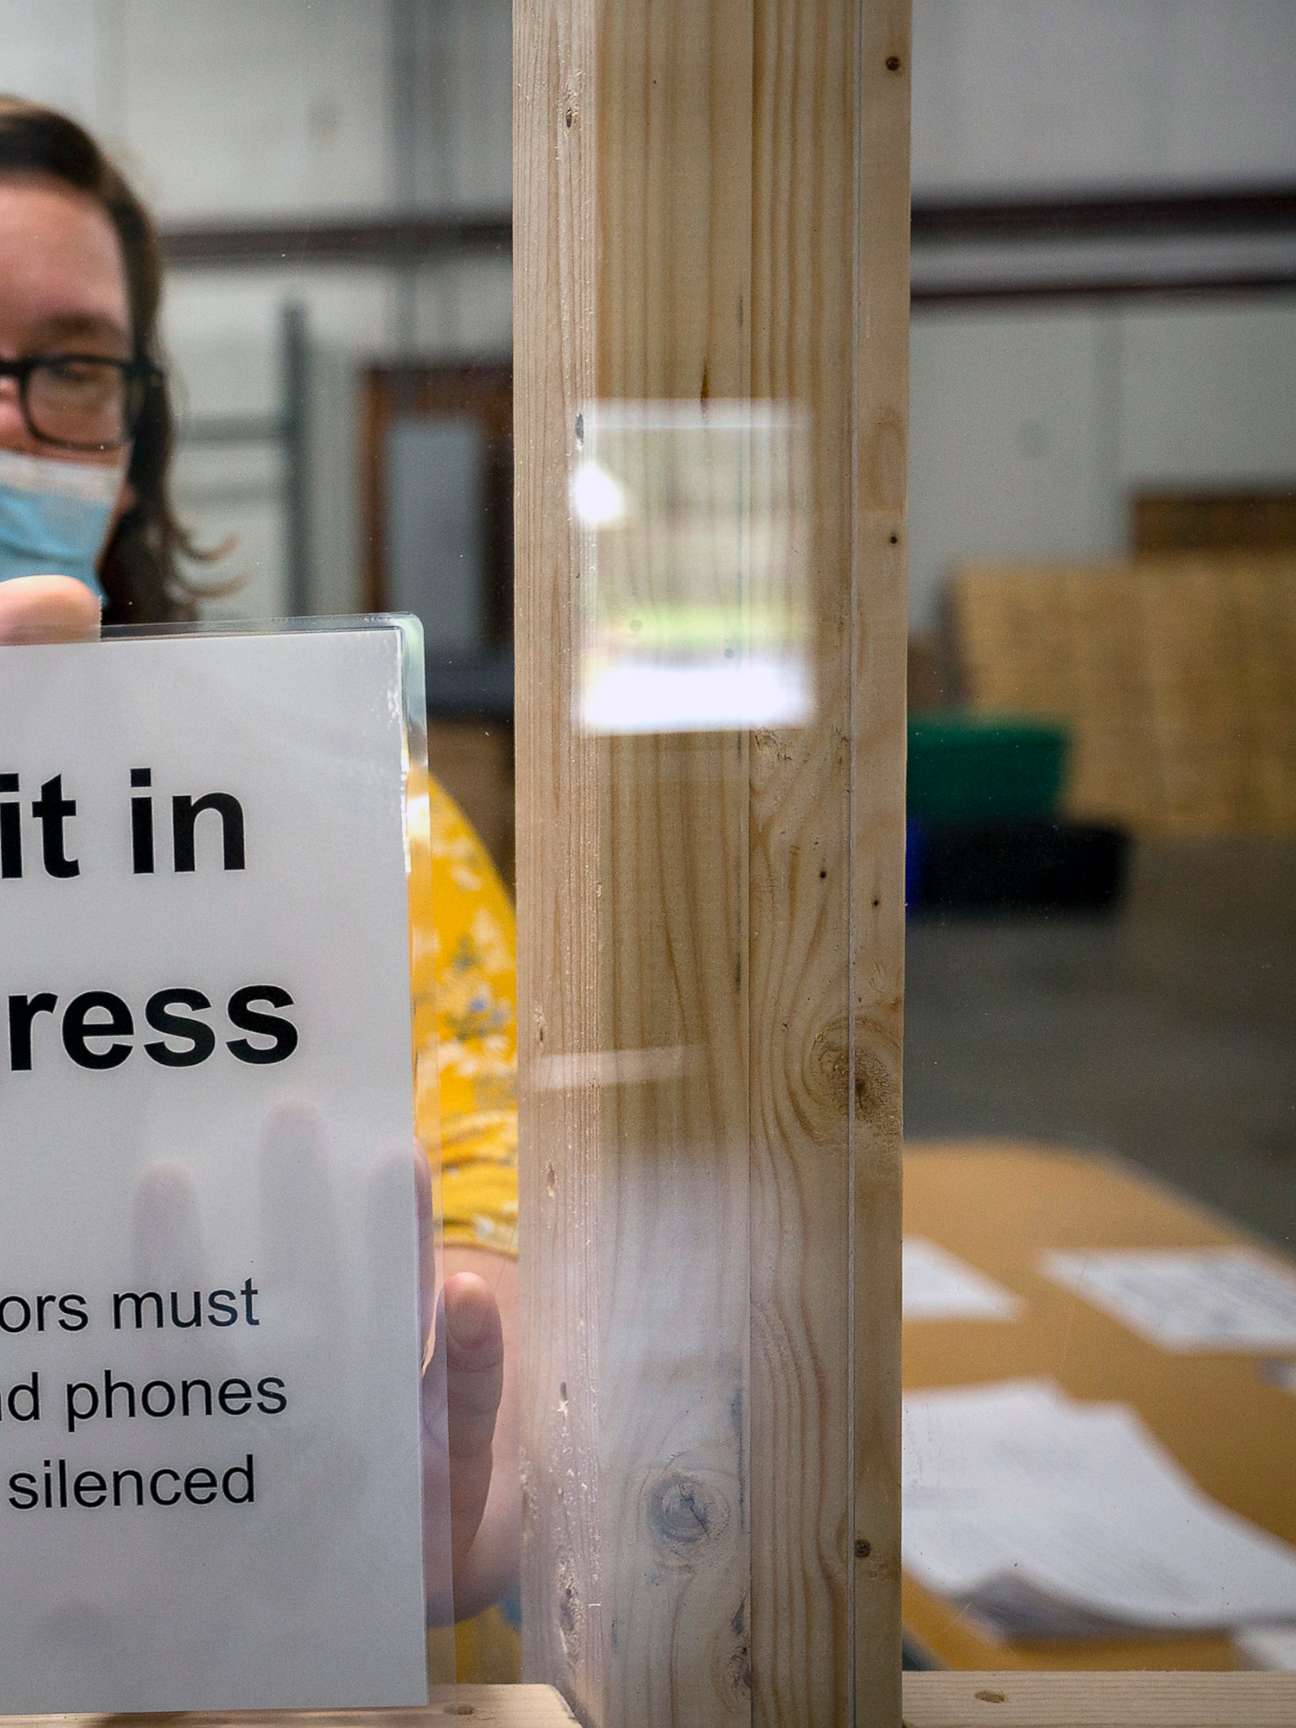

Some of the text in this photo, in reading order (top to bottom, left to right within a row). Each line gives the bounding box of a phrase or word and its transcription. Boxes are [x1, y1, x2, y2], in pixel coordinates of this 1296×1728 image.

[131, 768, 245, 874] in
[113, 1278, 259, 1329] must
[67, 1370, 287, 1432] phones
[9, 1454, 254, 1509] silenced
